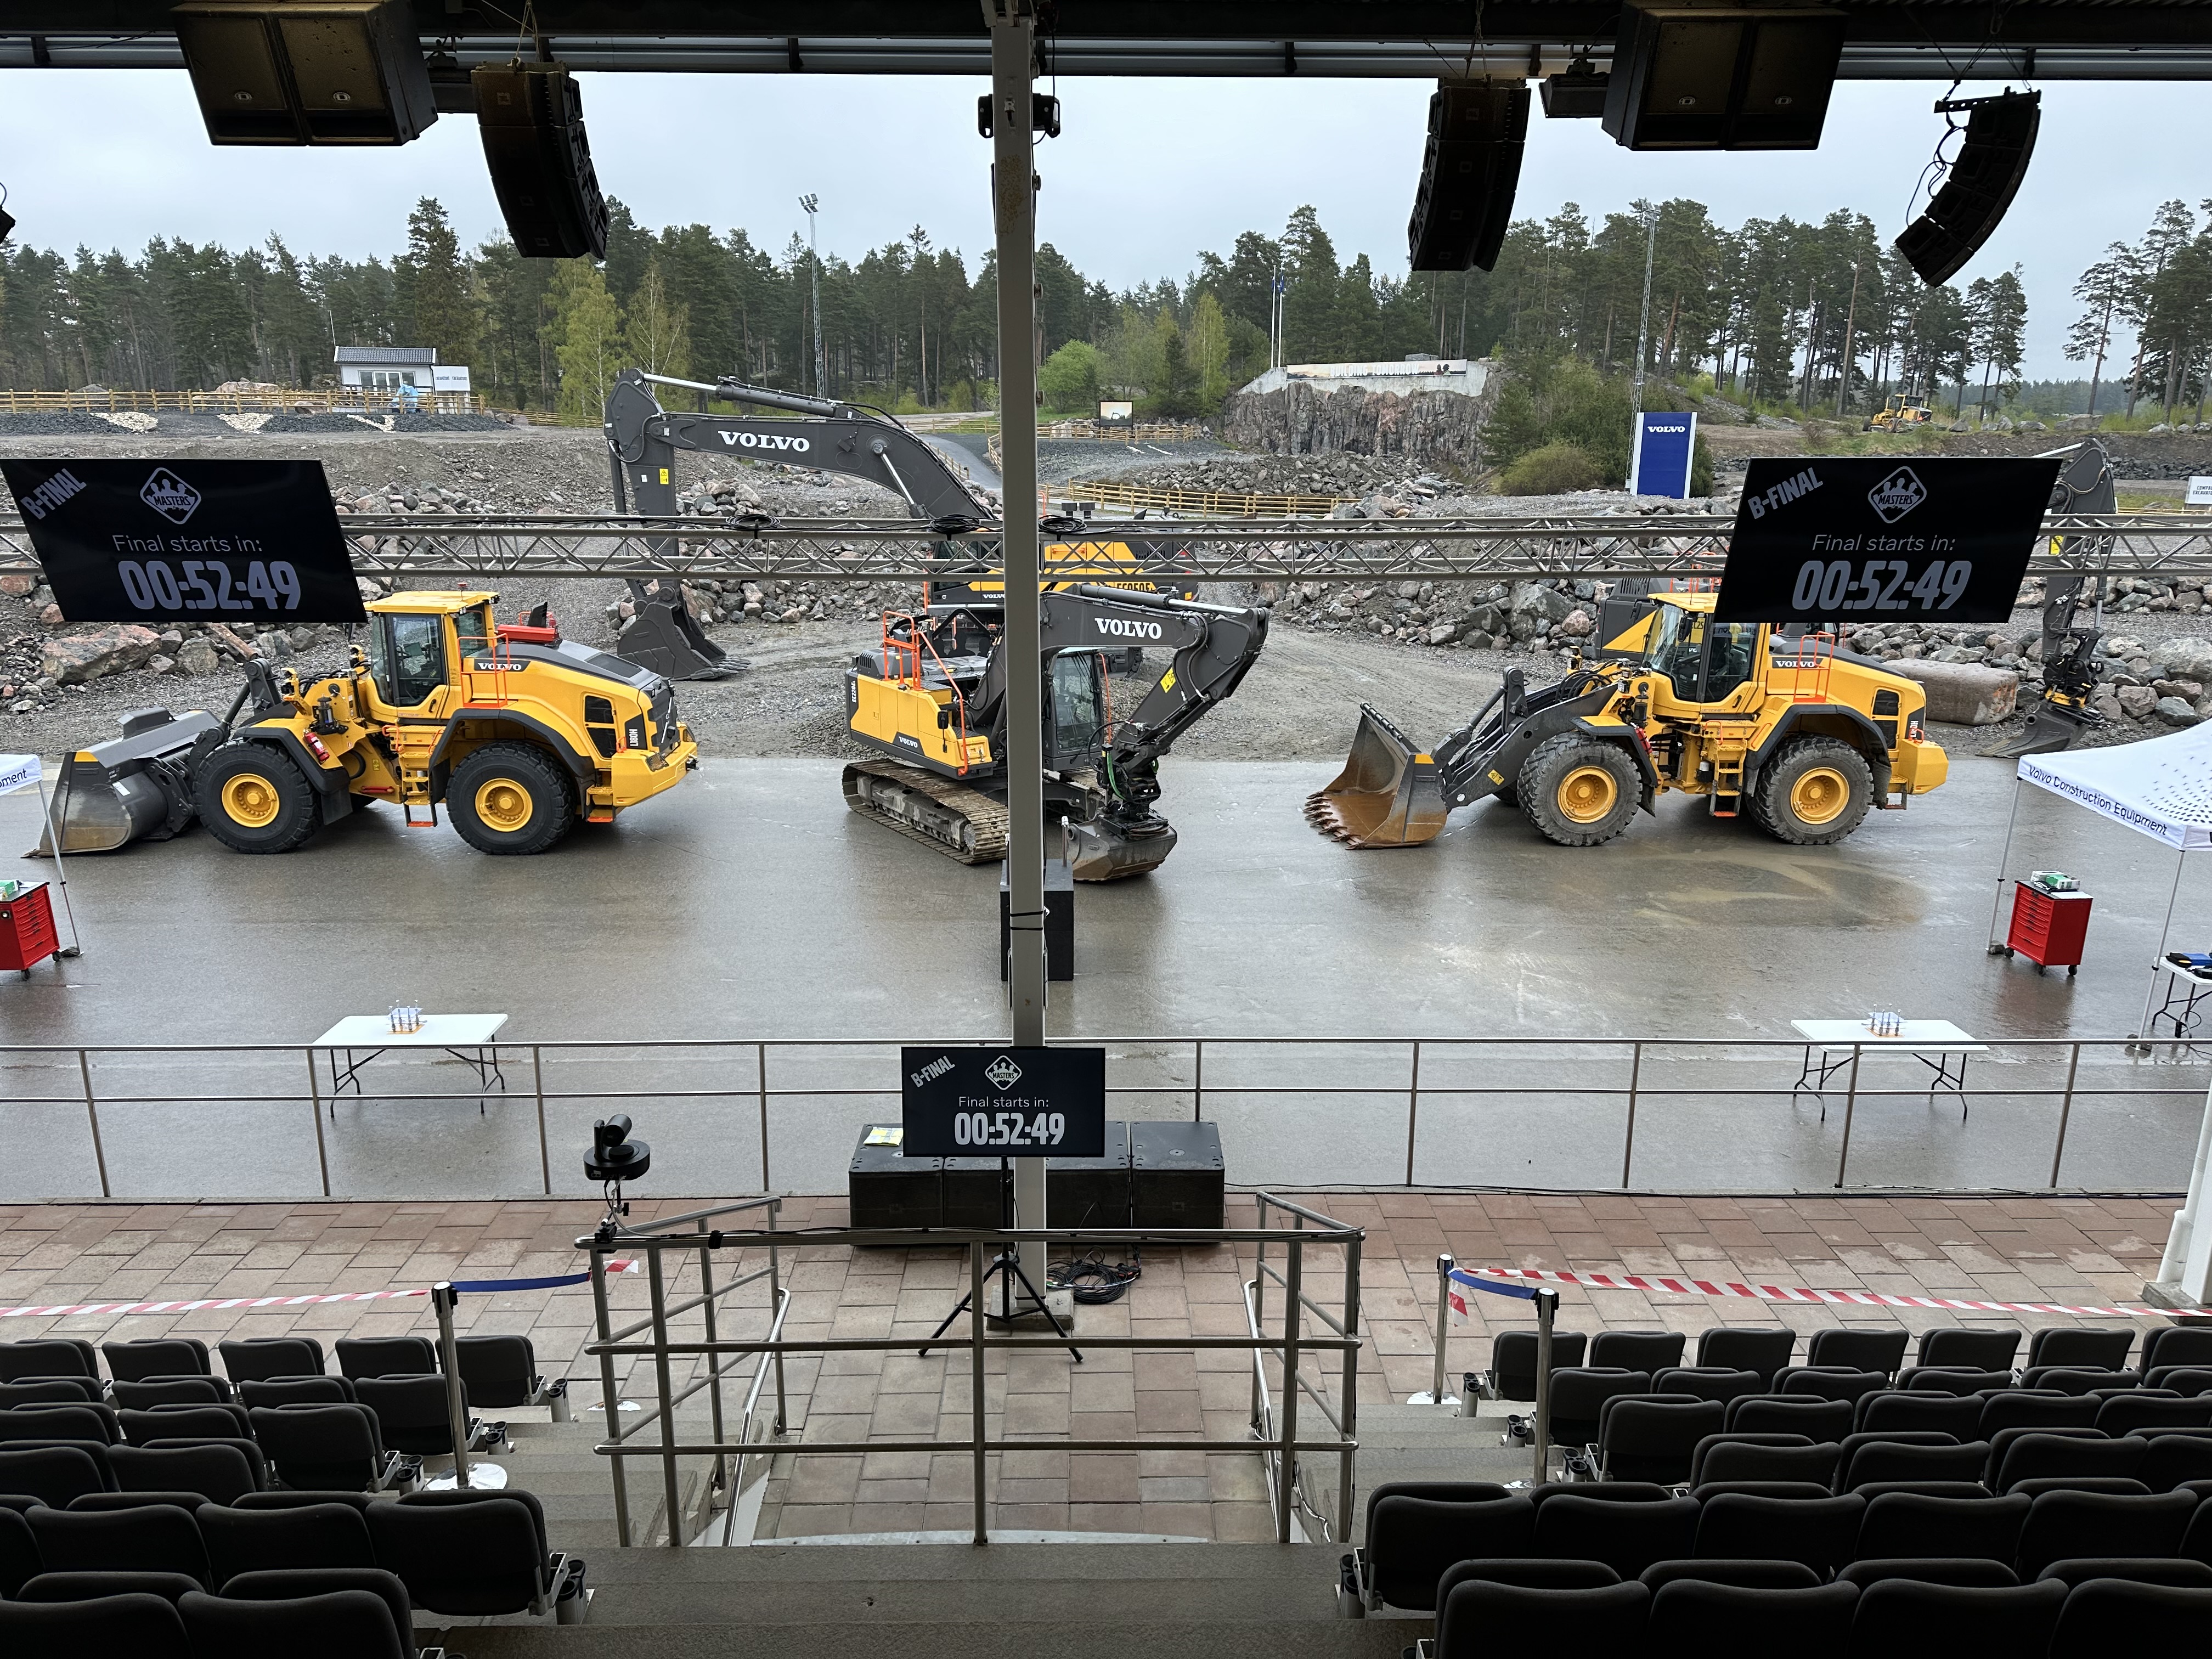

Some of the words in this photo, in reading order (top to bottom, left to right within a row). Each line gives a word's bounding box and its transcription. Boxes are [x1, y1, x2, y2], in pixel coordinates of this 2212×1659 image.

[1330, 365, 1368, 376] BUILDING
[1372, 363, 1419, 375] TOMORROW
[718, 430, 810, 452] VOLVO
[20, 468, 87, 520] B-FINAL
[154, 496, 190, 505] MASTERS
[1748, 467, 1823, 520] B-FINAL
[1877, 494, 1914, 505] MASTERS
[112, 535, 165, 552] Final
[171, 536, 230, 552] starts
[236, 535, 263, 552] in:
[1812, 534, 1860, 551] Final
[1866, 535, 1925, 551] starts
[1931, 534, 1955, 551] in:
[117, 560, 301, 610] 00:52:49
[1792, 560, 1972, 610] 00:52:49
[1094, 617, 1163, 640] VOLVO
[477, 662, 521, 671] VOLVO
[629, 729, 638, 746] L180H
[899, 736, 918, 748] VOLVO
[2029, 765, 2052, 783] Volvo
[2053, 776, 2111, 810] Construction
[2114, 802, 2168, 835] Equipment
[910, 1056, 955, 1088] B-FINAL
[959, 1096, 988, 1107] Final
[993, 1097, 1029, 1107] starts
[1034, 1096, 1048, 1107] in:
[954, 1113, 1065, 1145] 00:52:49
